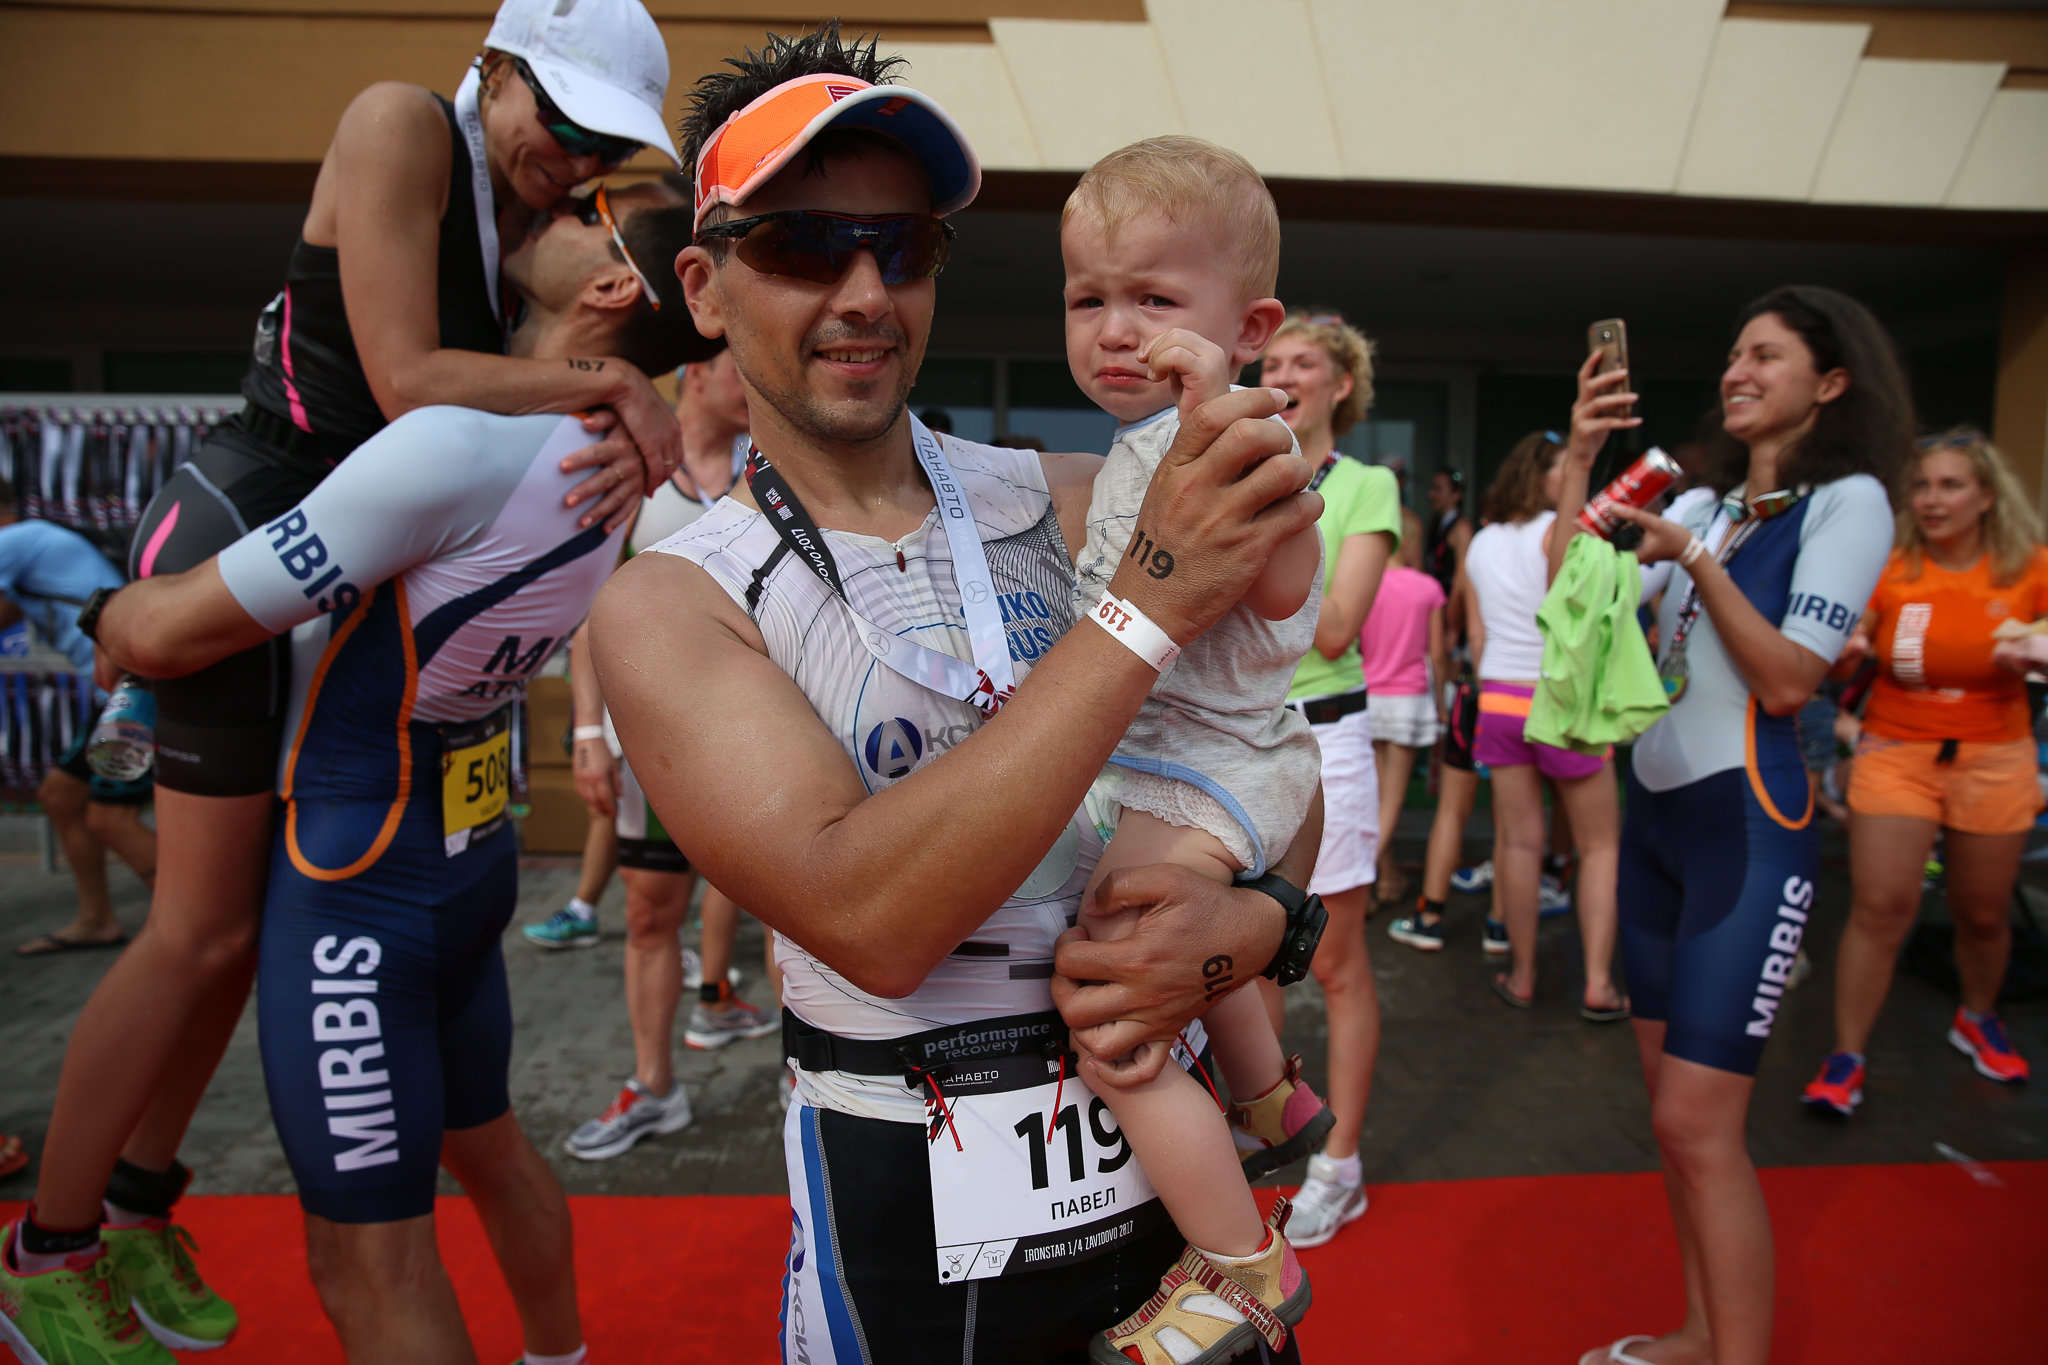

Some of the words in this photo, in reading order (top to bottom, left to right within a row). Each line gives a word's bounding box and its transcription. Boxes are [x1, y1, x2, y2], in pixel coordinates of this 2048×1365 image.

[465, 111, 489, 192] ПАНАВТО
[565, 358, 605, 373] 187
[920, 436, 965, 519] ПАНАВТО
[790, 529, 816, 551] 2017
[1129, 530, 1175, 580] 119
[265, 508, 362, 613] RBIS
[1100, 601, 1133, 632] 119
[1745, 875, 1814, 1038] MIRBIS
[1202, 954, 1234, 1003] 119
[311, 934, 400, 1172] MIRBIS
[924, 1023, 1050, 1058] performance
[945, 1039, 1019, 1060] recovery
[941, 1070, 999, 1084] АНАВТО
[1013, 1096, 1133, 1190] 119
[1051, 1187, 1117, 1221] ПАВЕЛ
[991, 1255, 998, 1265] M
[1024, 1243, 1066, 1263] IRONSTAR
[1067, 1239, 1083, 1257] 1/4
[1084, 1226, 1118, 1251] ZAVIDOVO
[1118, 1220, 1134, 1238] 2017
[1243, 1300, 1270, 1326] Quechua
